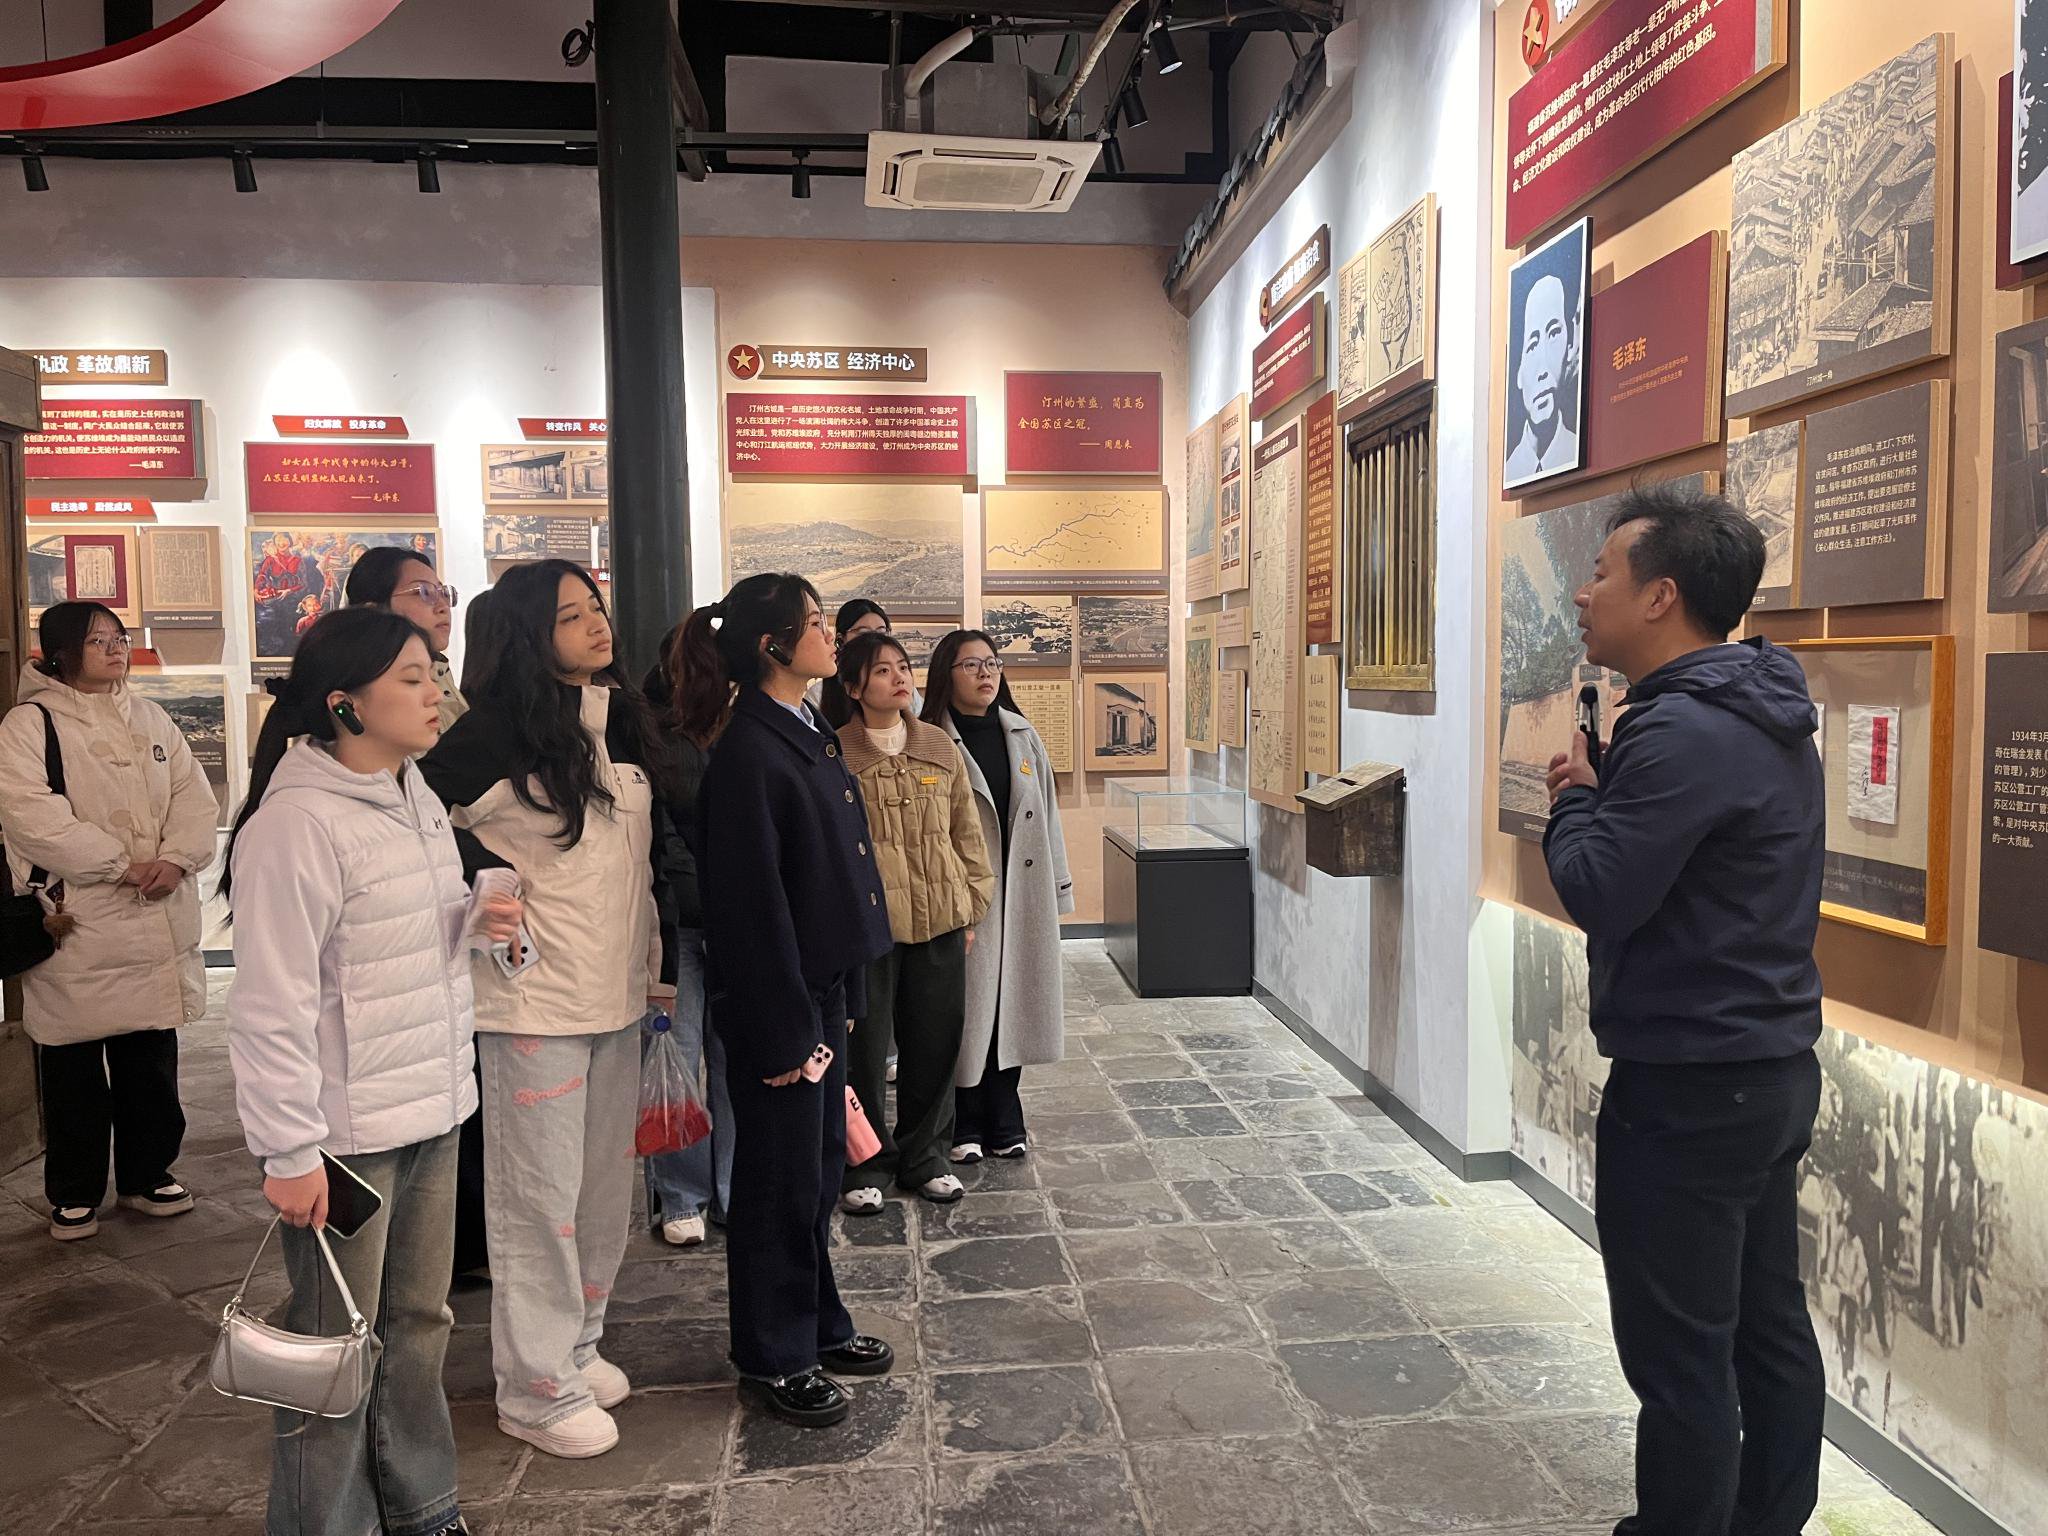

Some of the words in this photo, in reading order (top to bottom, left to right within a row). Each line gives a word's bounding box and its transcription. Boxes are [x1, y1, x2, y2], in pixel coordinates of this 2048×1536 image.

[772, 350, 840, 369] 中央苏区
[846, 351, 915, 371] 经济中心
[1612, 336, 1647, 371] 毛泽东
[76, 354, 151, 375] 革故鼎新
[545, 421, 582, 432] 转变作风
[1017, 416, 1091, 431] 全国苏区之冠。
[735, 451, 761, 462] 济中心。
[1994, 764, 2048, 779] 的管理》，刘少
[1991, 832, 2035, 850] 的一大贡献。
